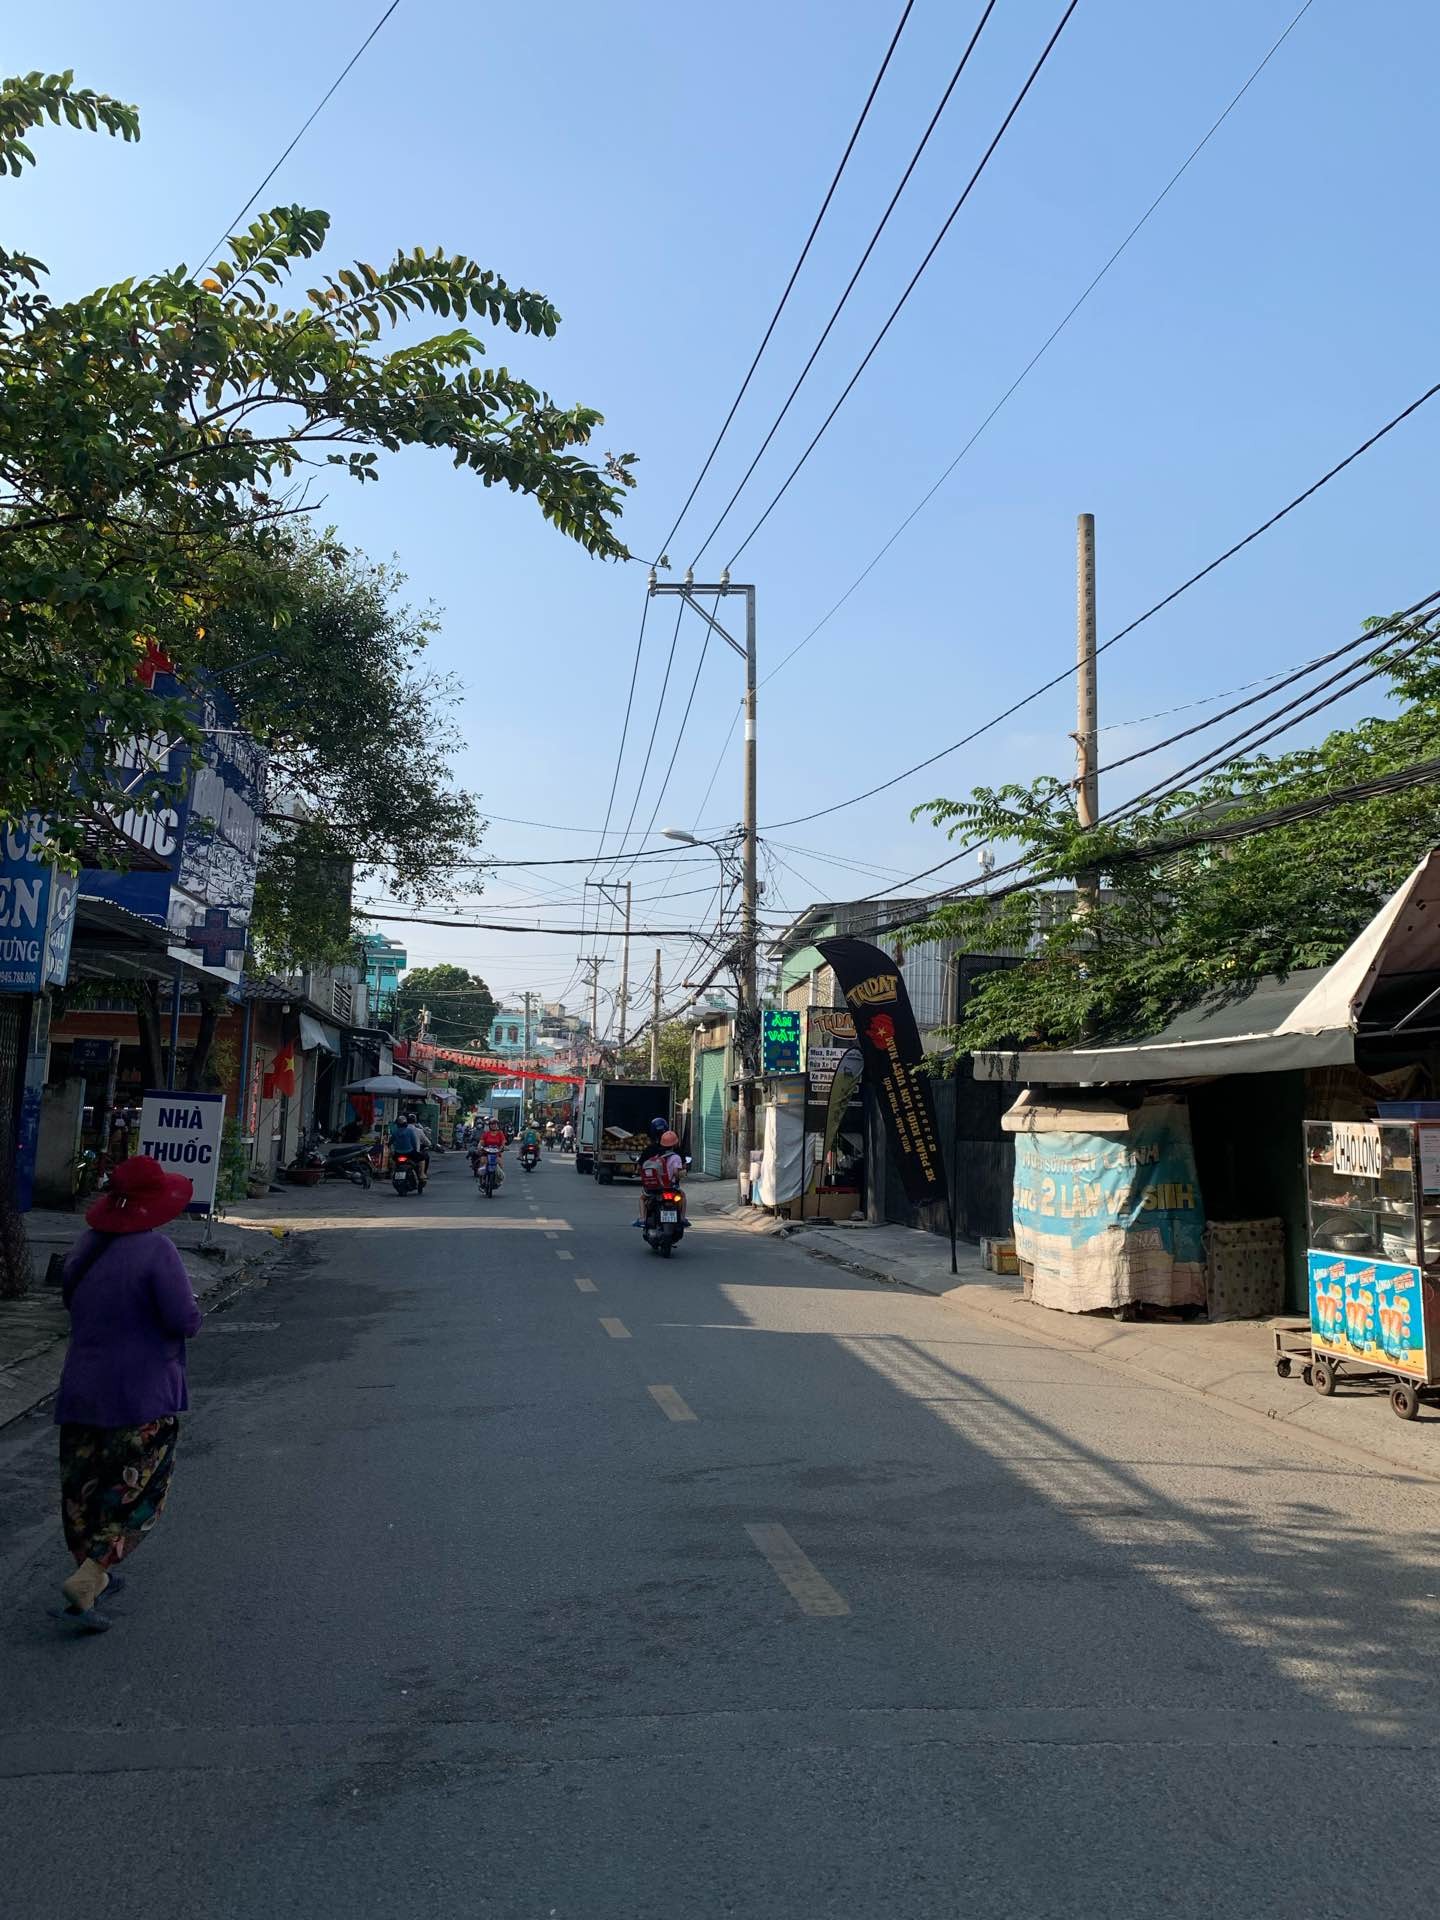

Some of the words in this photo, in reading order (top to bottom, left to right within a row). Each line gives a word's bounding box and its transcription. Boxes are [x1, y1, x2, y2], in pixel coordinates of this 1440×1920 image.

[771, 1014, 792, 1027] ĂN
[158, 1106, 203, 1130] NHÀ
[143, 1137, 212, 1164] THUỐC
[1040, 1177, 1057, 1217] 2
